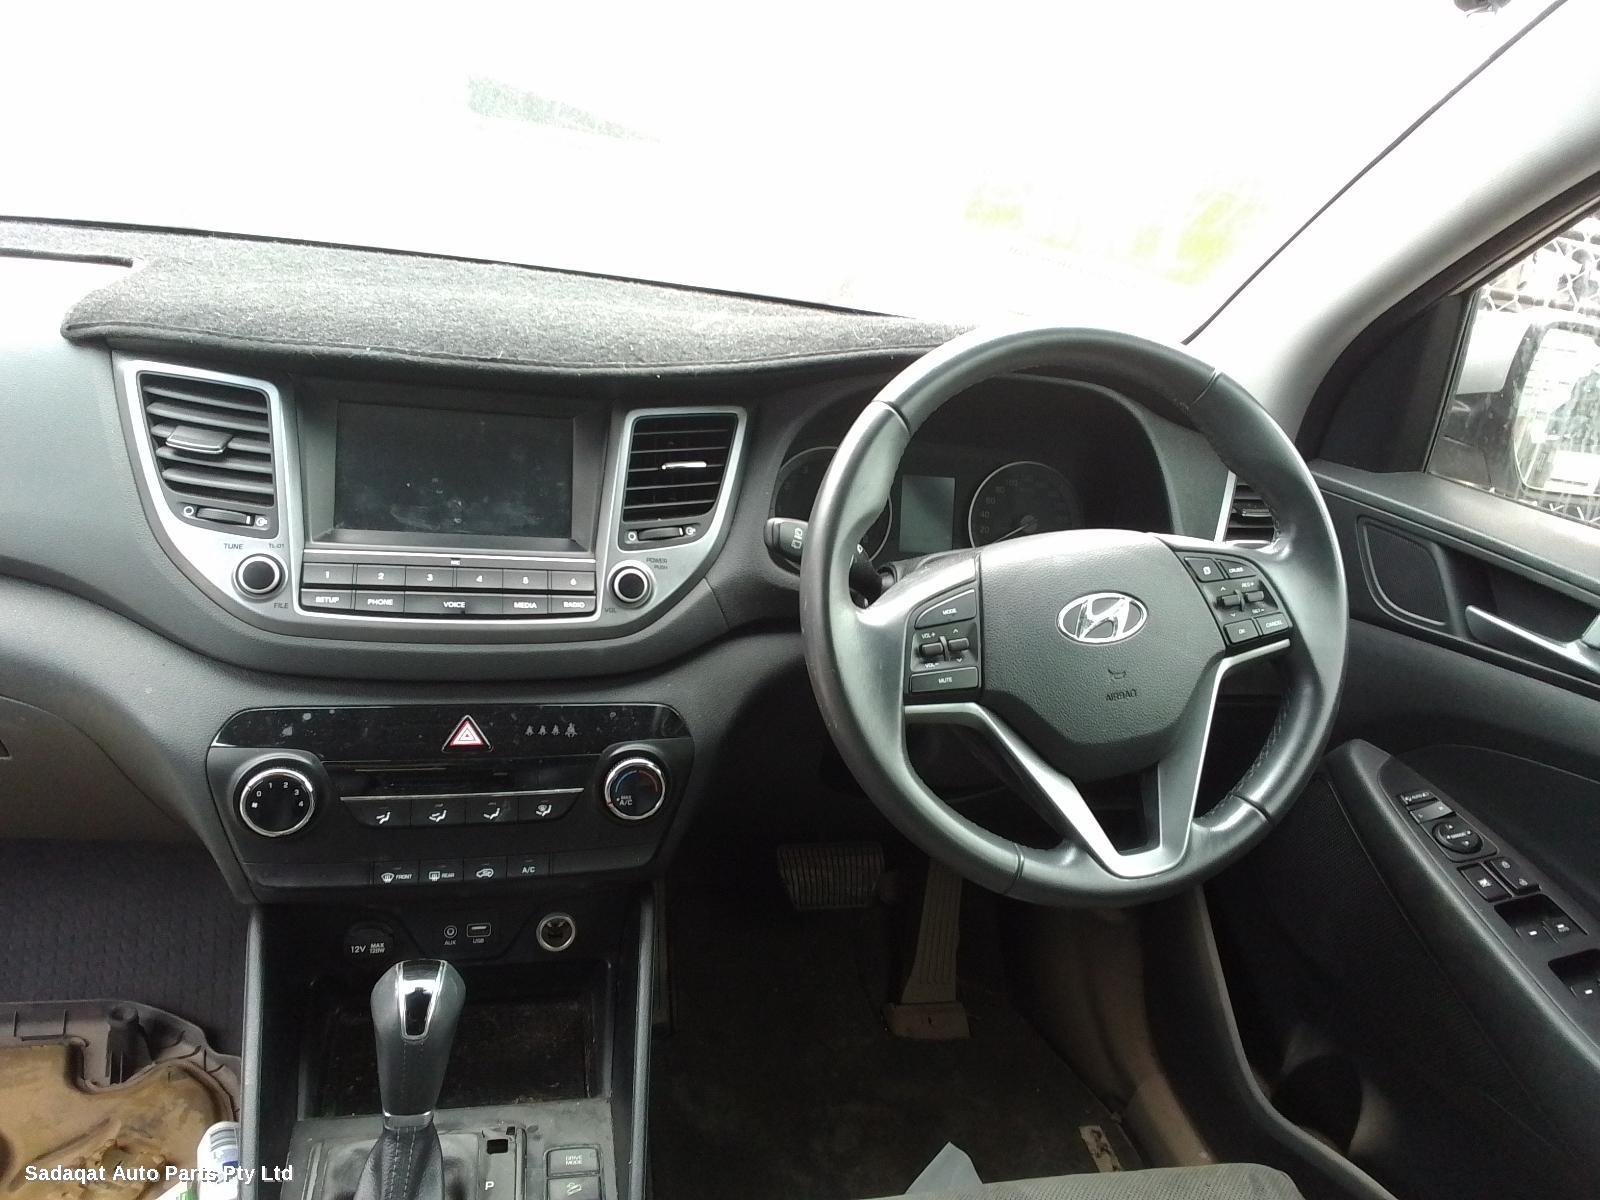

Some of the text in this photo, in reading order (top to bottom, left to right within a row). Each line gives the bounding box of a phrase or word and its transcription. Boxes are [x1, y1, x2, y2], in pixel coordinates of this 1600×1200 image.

[223, 542, 244, 550] TUNE
[315, 595, 340, 604] SETUP
[367, 598, 394, 607] PHONE
[273, 602, 289, 610] FILE
[443, 601, 466, 609] VOICE
[513, 601, 538, 609] MEDIA
[563, 601, 586, 609] RADIO
[938, 676, 953, 684] MUTE
[521, 866, 536, 874] A/C
[350, 945, 367, 954] 12V
[484, 1181, 495, 1191] P
